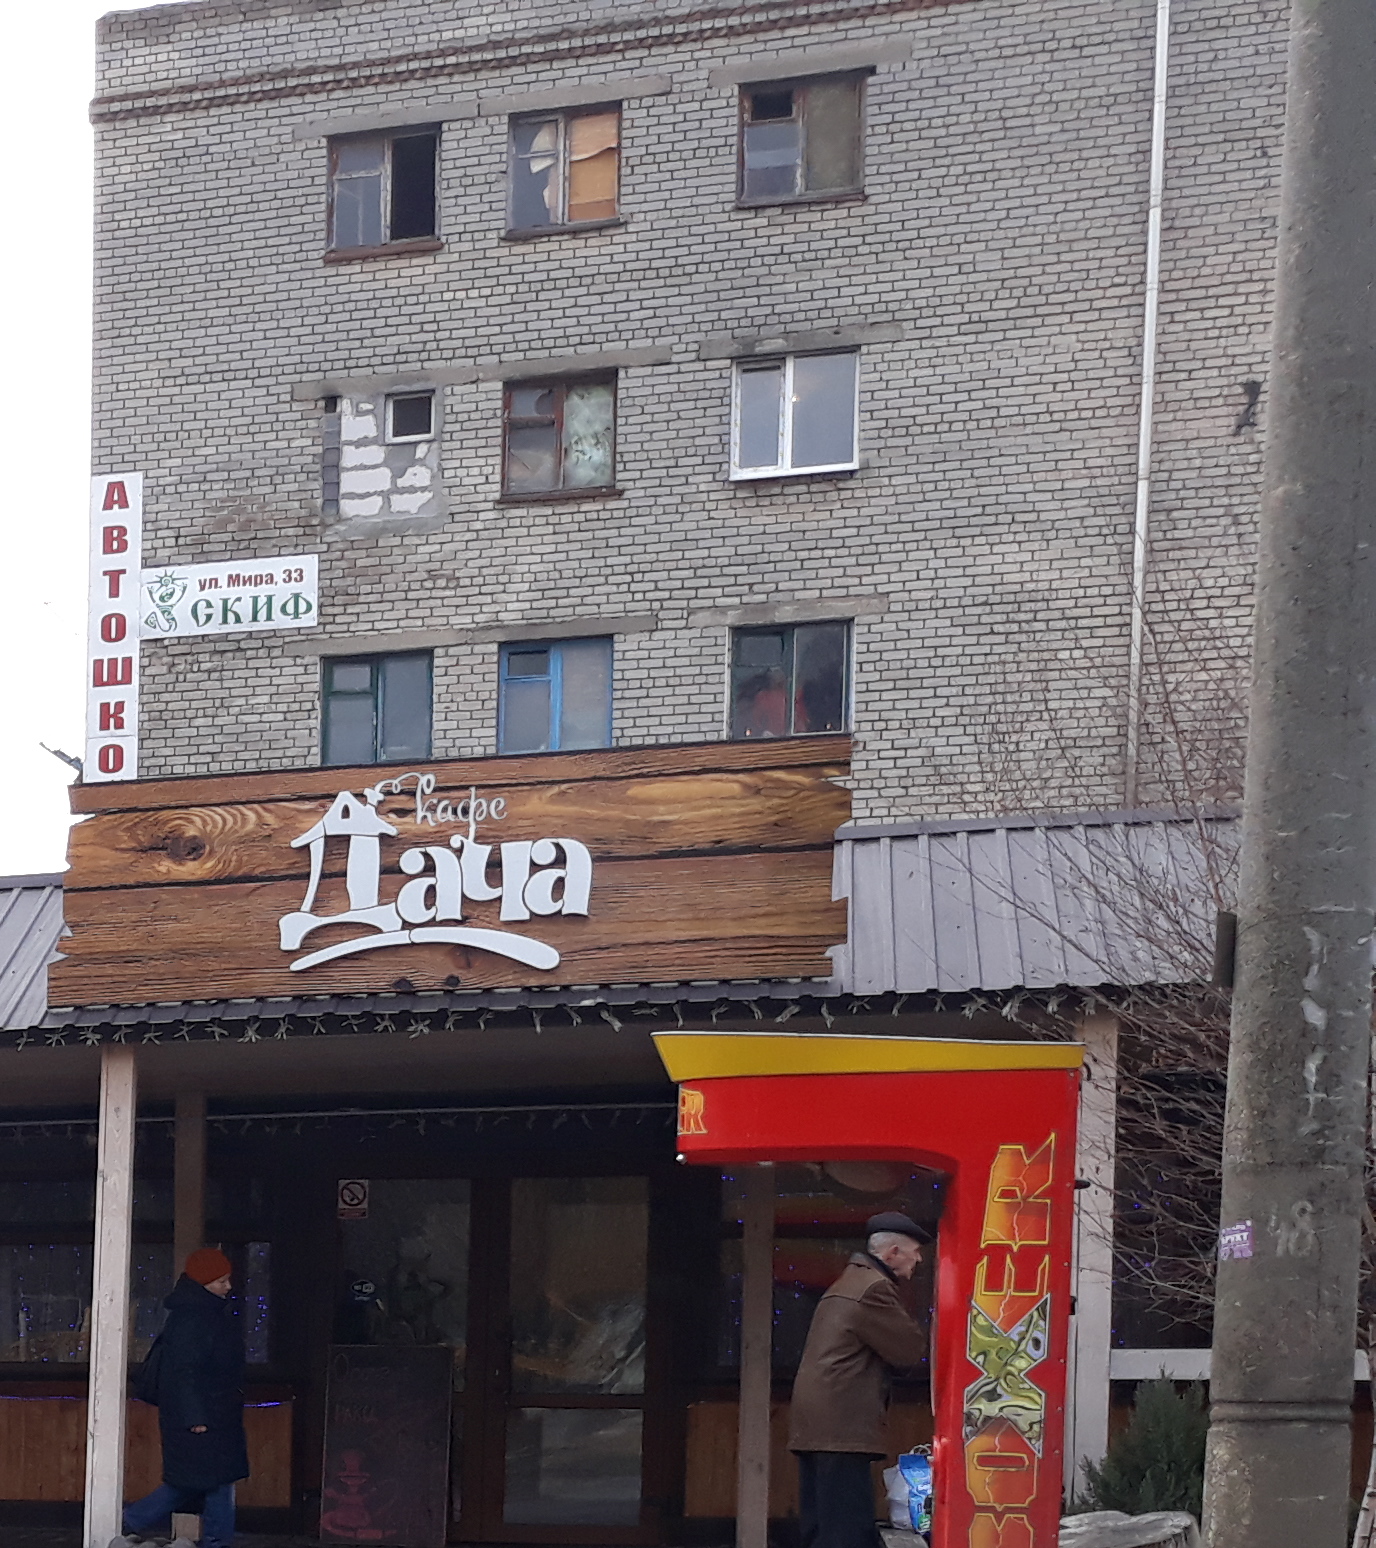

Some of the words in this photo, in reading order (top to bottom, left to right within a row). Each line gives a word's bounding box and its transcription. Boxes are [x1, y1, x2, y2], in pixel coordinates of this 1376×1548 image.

[190, 591, 313, 627] СКИФ
[197, 577, 223, 592] ул.
[227, 571, 279, 588] Мира,
[282, 567, 304, 584] 33
[93, 480, 133, 774] АВТОШКО
[414, 772, 510, 836] кафе
[279, 788, 593, 950] Дача
